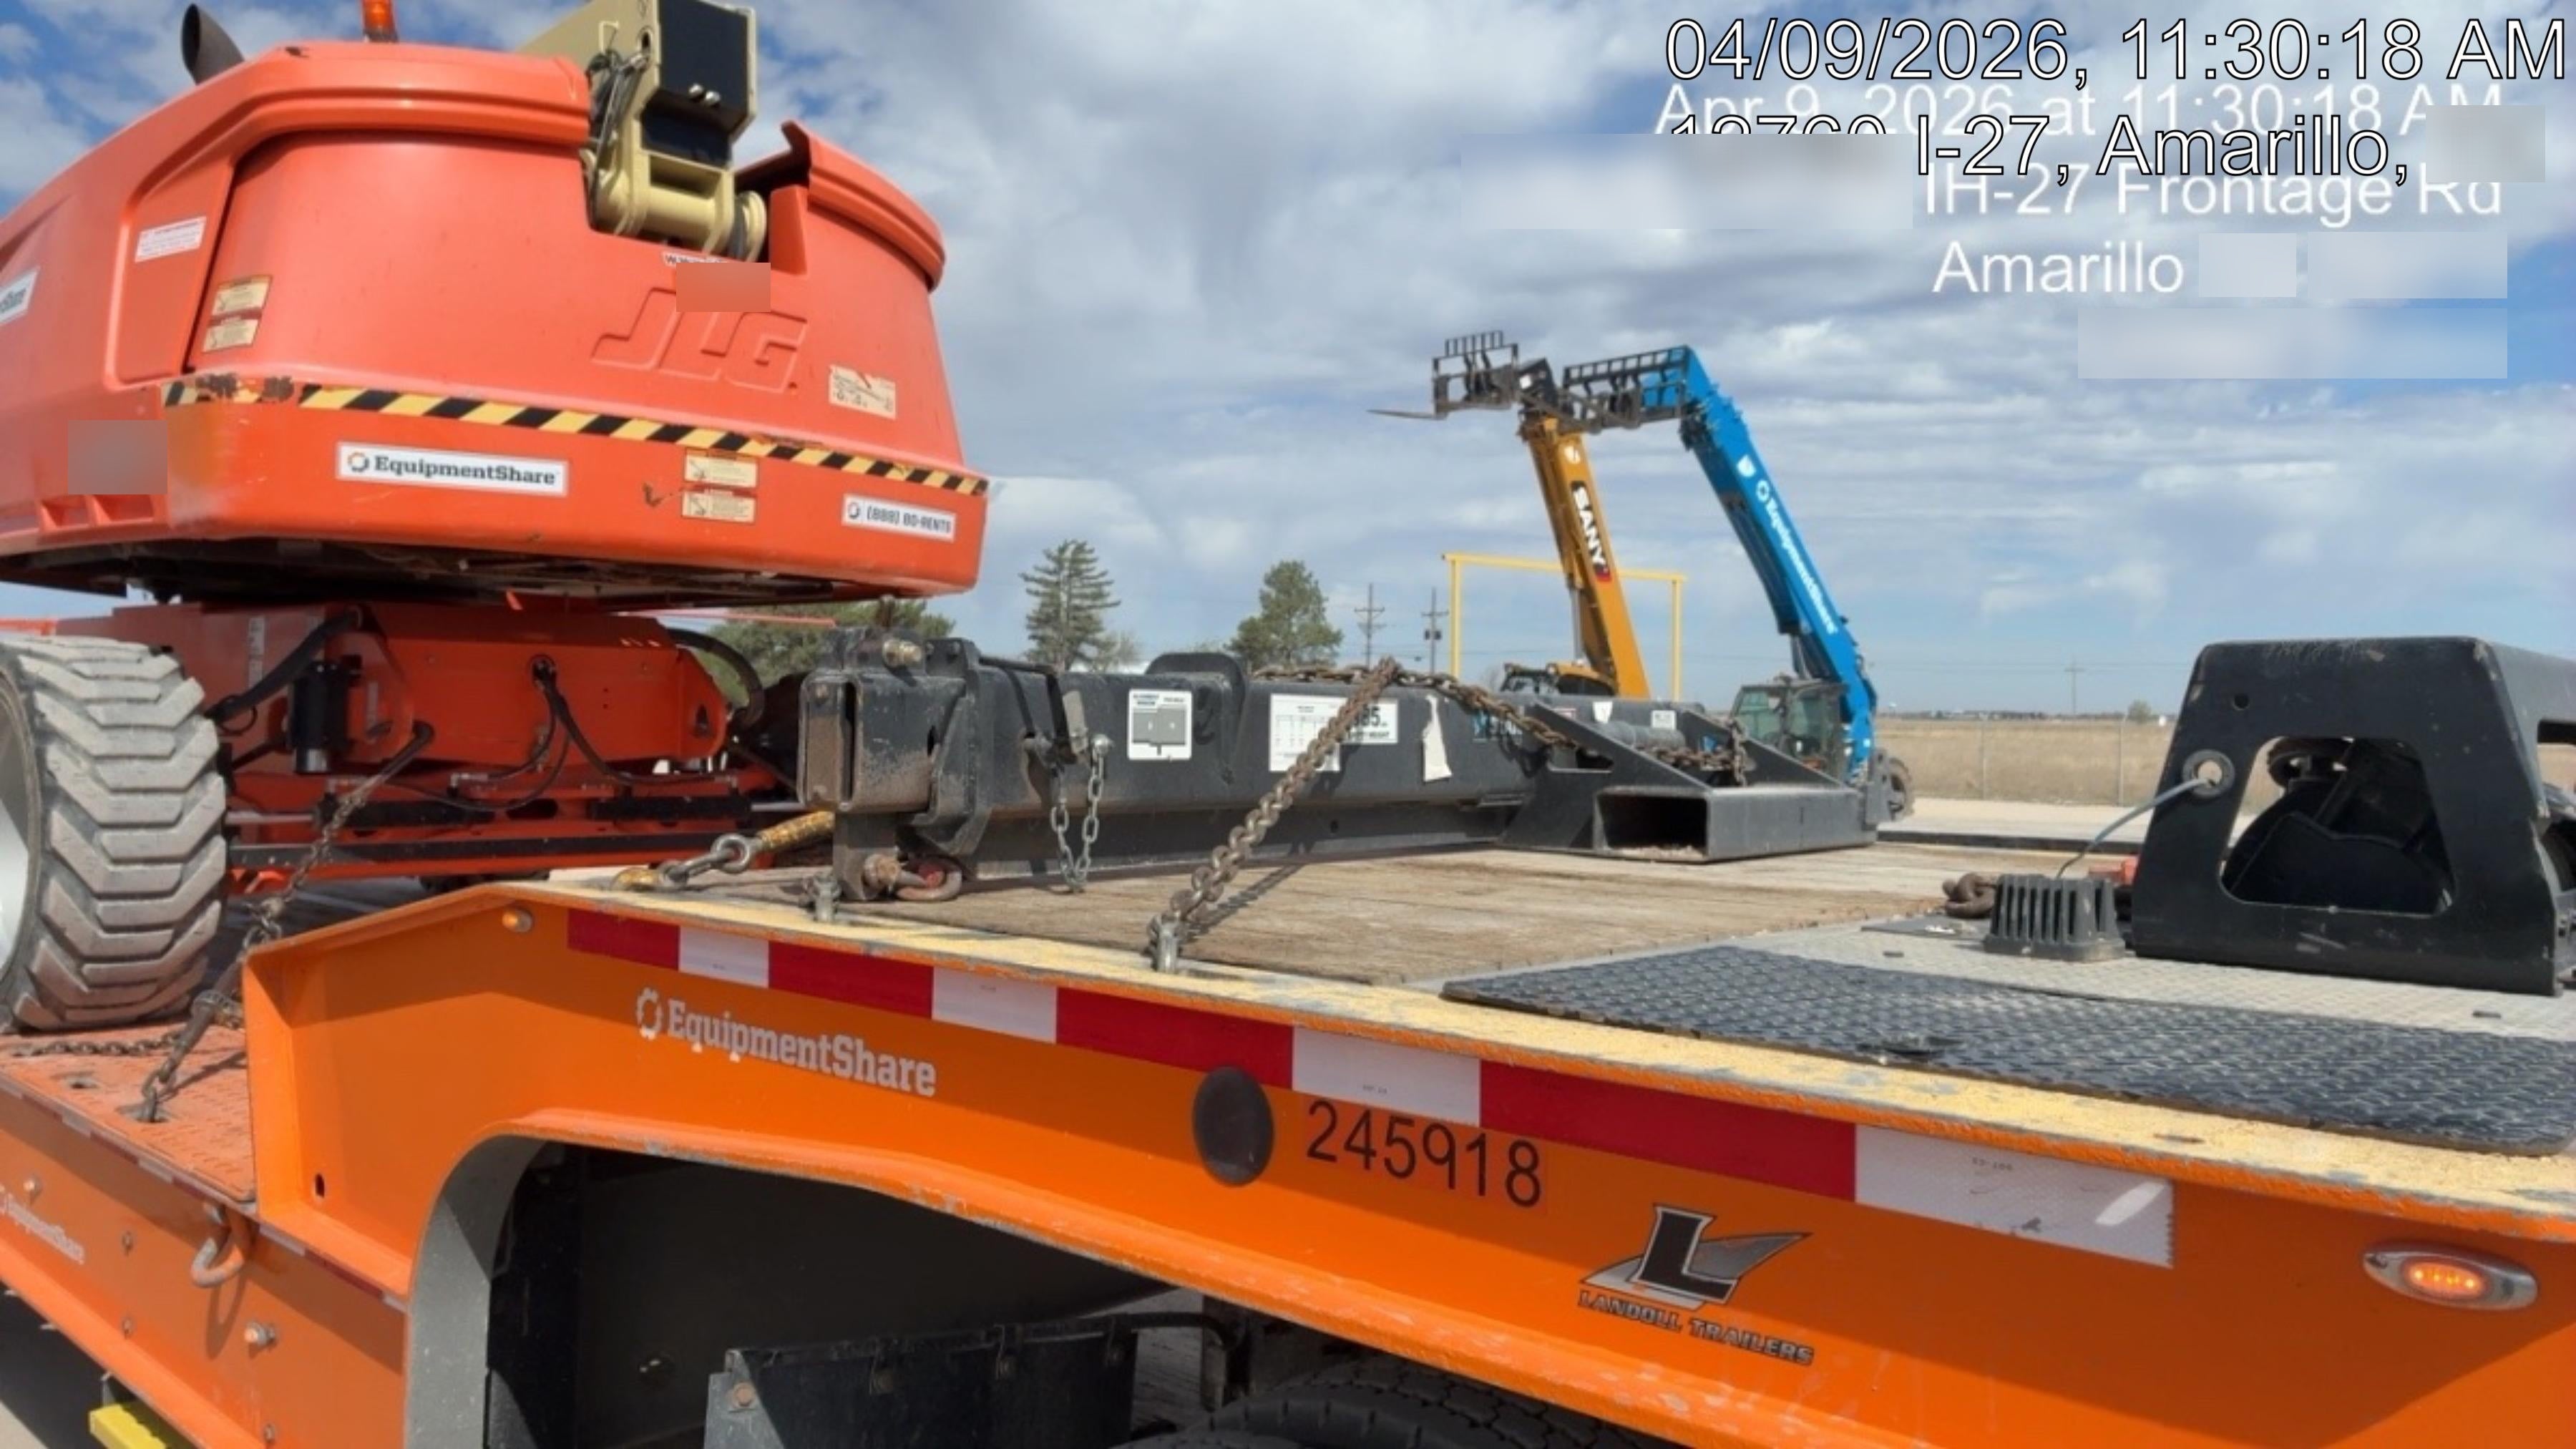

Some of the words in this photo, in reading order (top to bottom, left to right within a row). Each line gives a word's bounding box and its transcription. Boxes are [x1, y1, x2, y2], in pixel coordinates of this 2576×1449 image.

[374, 456, 556, 484] EquipmentShare
[1574, 487, 1606, 565] SANY
[668, 998, 937, 1097] EquipmentShare
[1307, 1100, 1541, 1208] 245918
[1578, 1289, 1683, 1333] LANDOLL
[1689, 1317, 1816, 1366] TRAILERS
